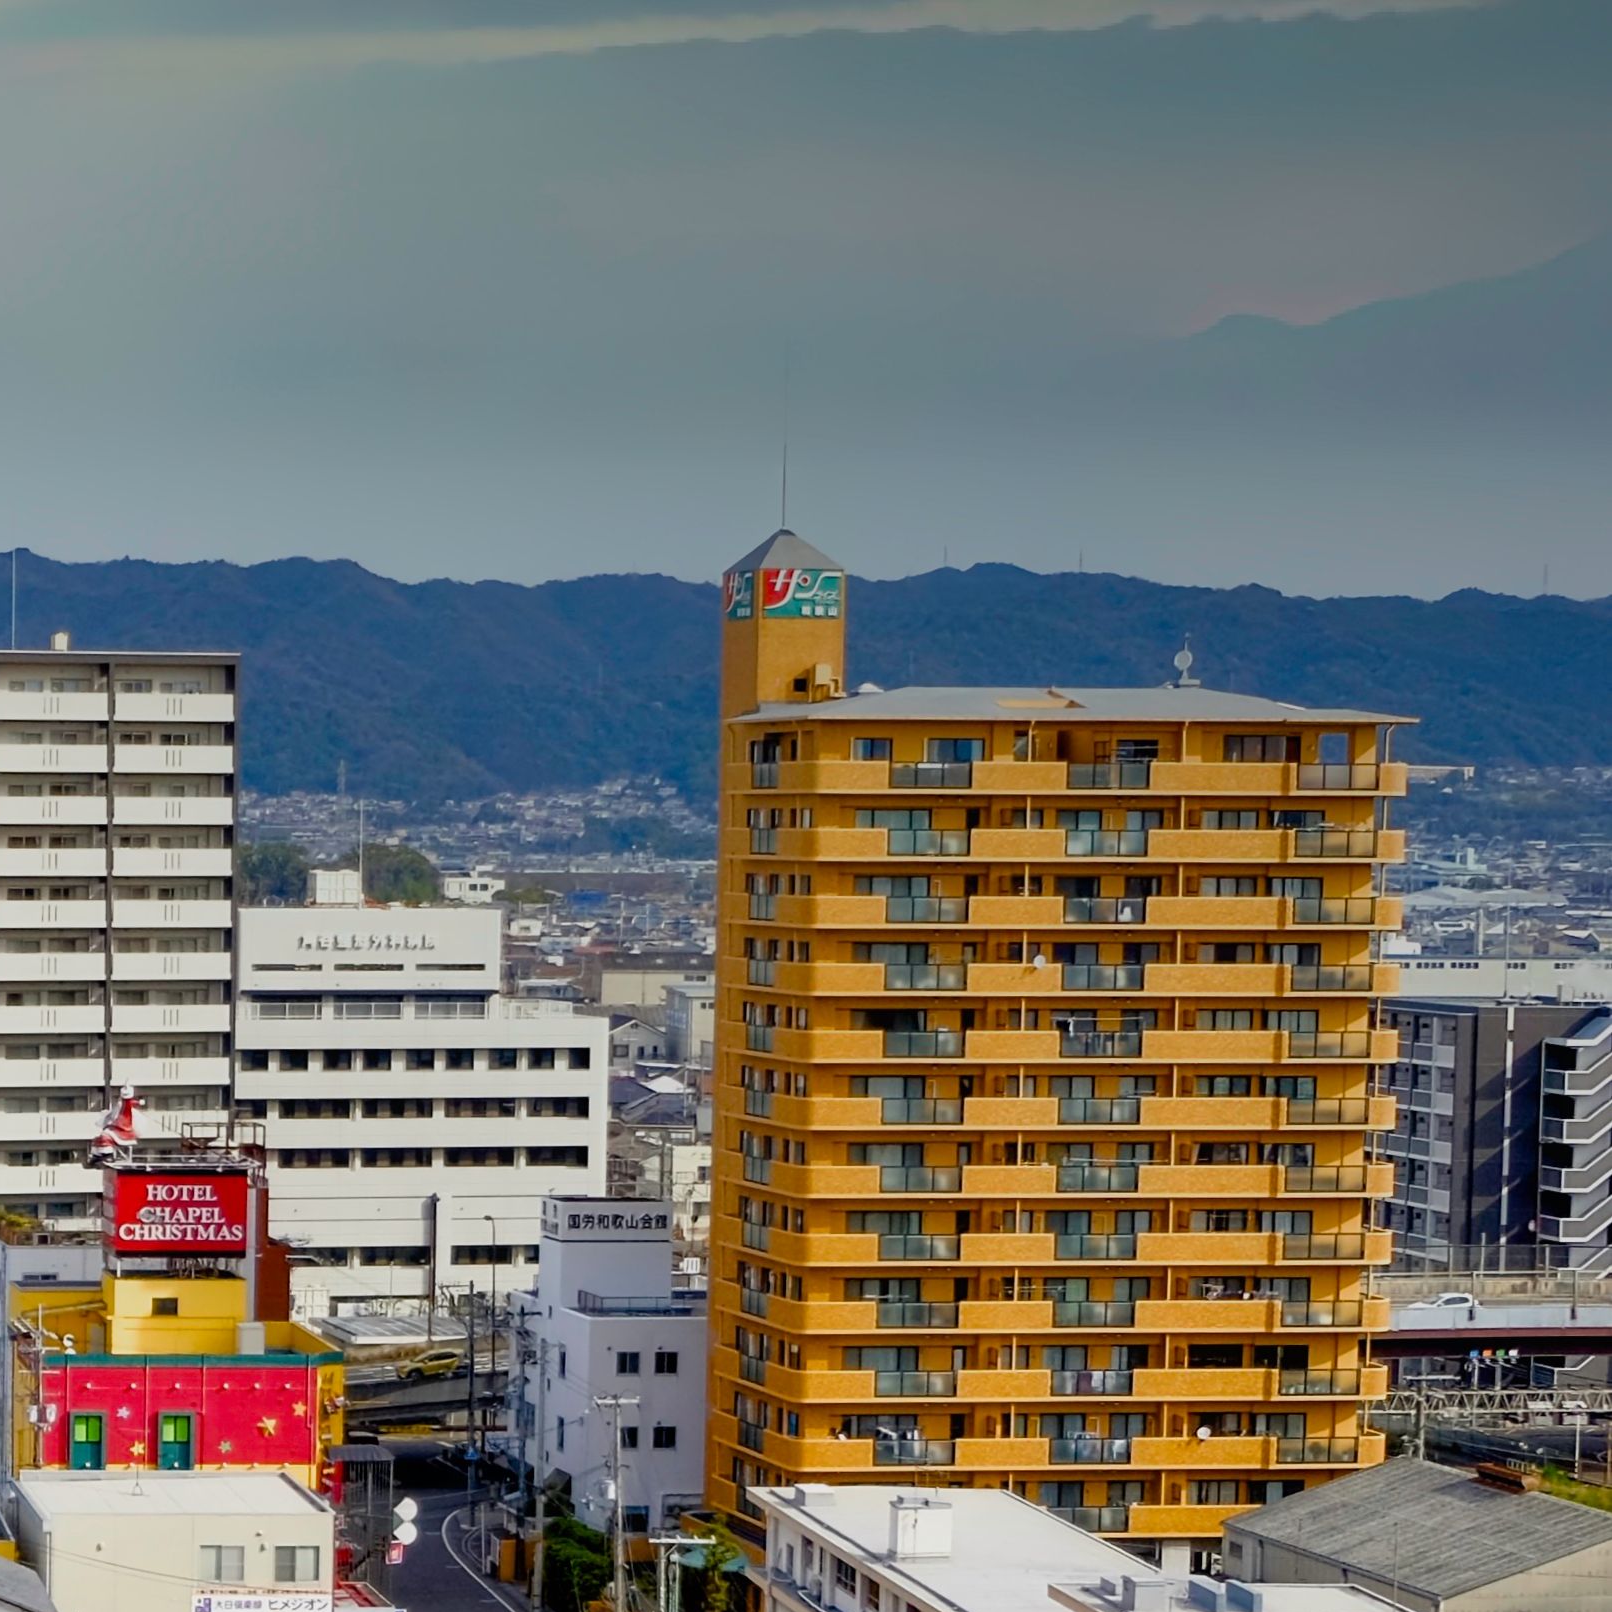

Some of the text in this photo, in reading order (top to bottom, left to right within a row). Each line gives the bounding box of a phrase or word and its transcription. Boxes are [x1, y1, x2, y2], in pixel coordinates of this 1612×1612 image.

[145, 1184, 218, 1201] HOTEL
[137, 1207, 226, 1224] CHAPEL
[118, 1223, 244, 1241] CHRISTMAS
[268, 1599, 329, 1611] ヒメジオン
